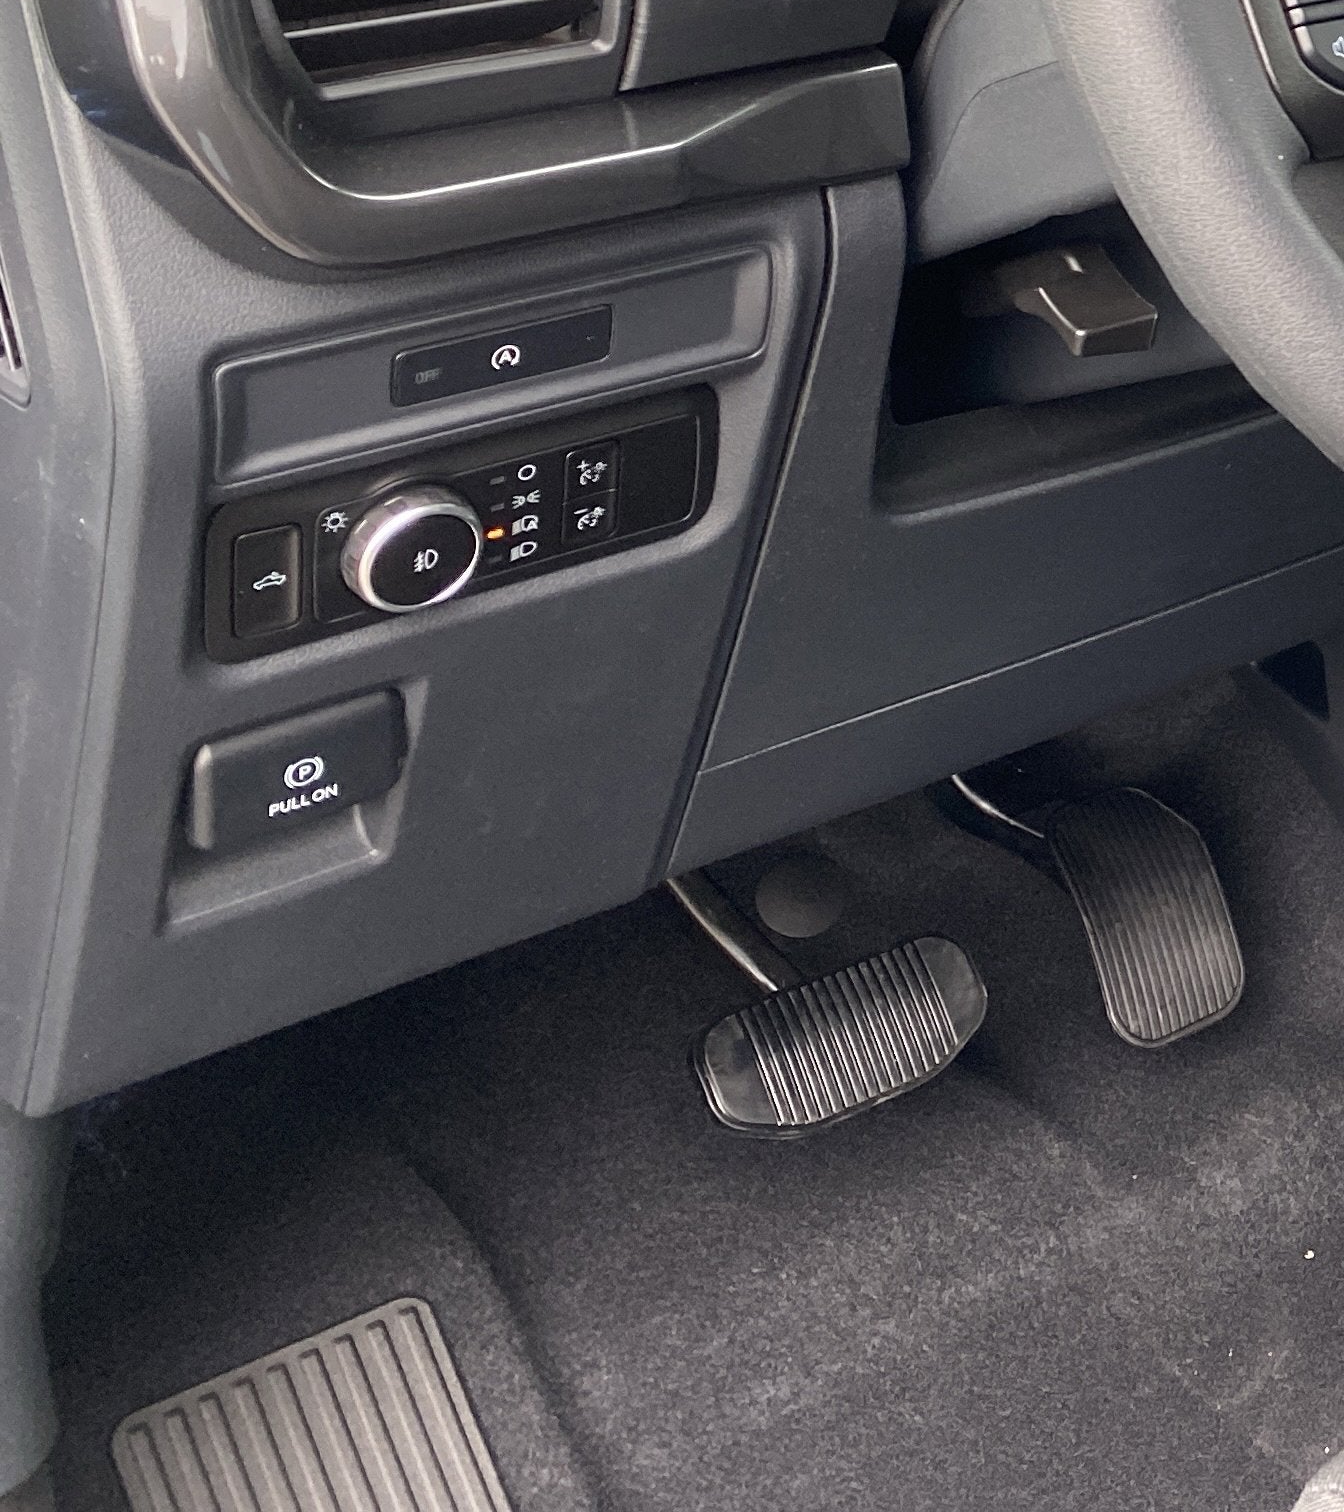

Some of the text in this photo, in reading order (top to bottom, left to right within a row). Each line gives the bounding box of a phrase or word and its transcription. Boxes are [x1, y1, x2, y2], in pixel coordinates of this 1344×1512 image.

[414, 368, 443, 385] OFF
[268, 783, 338, 817] PULL ON
